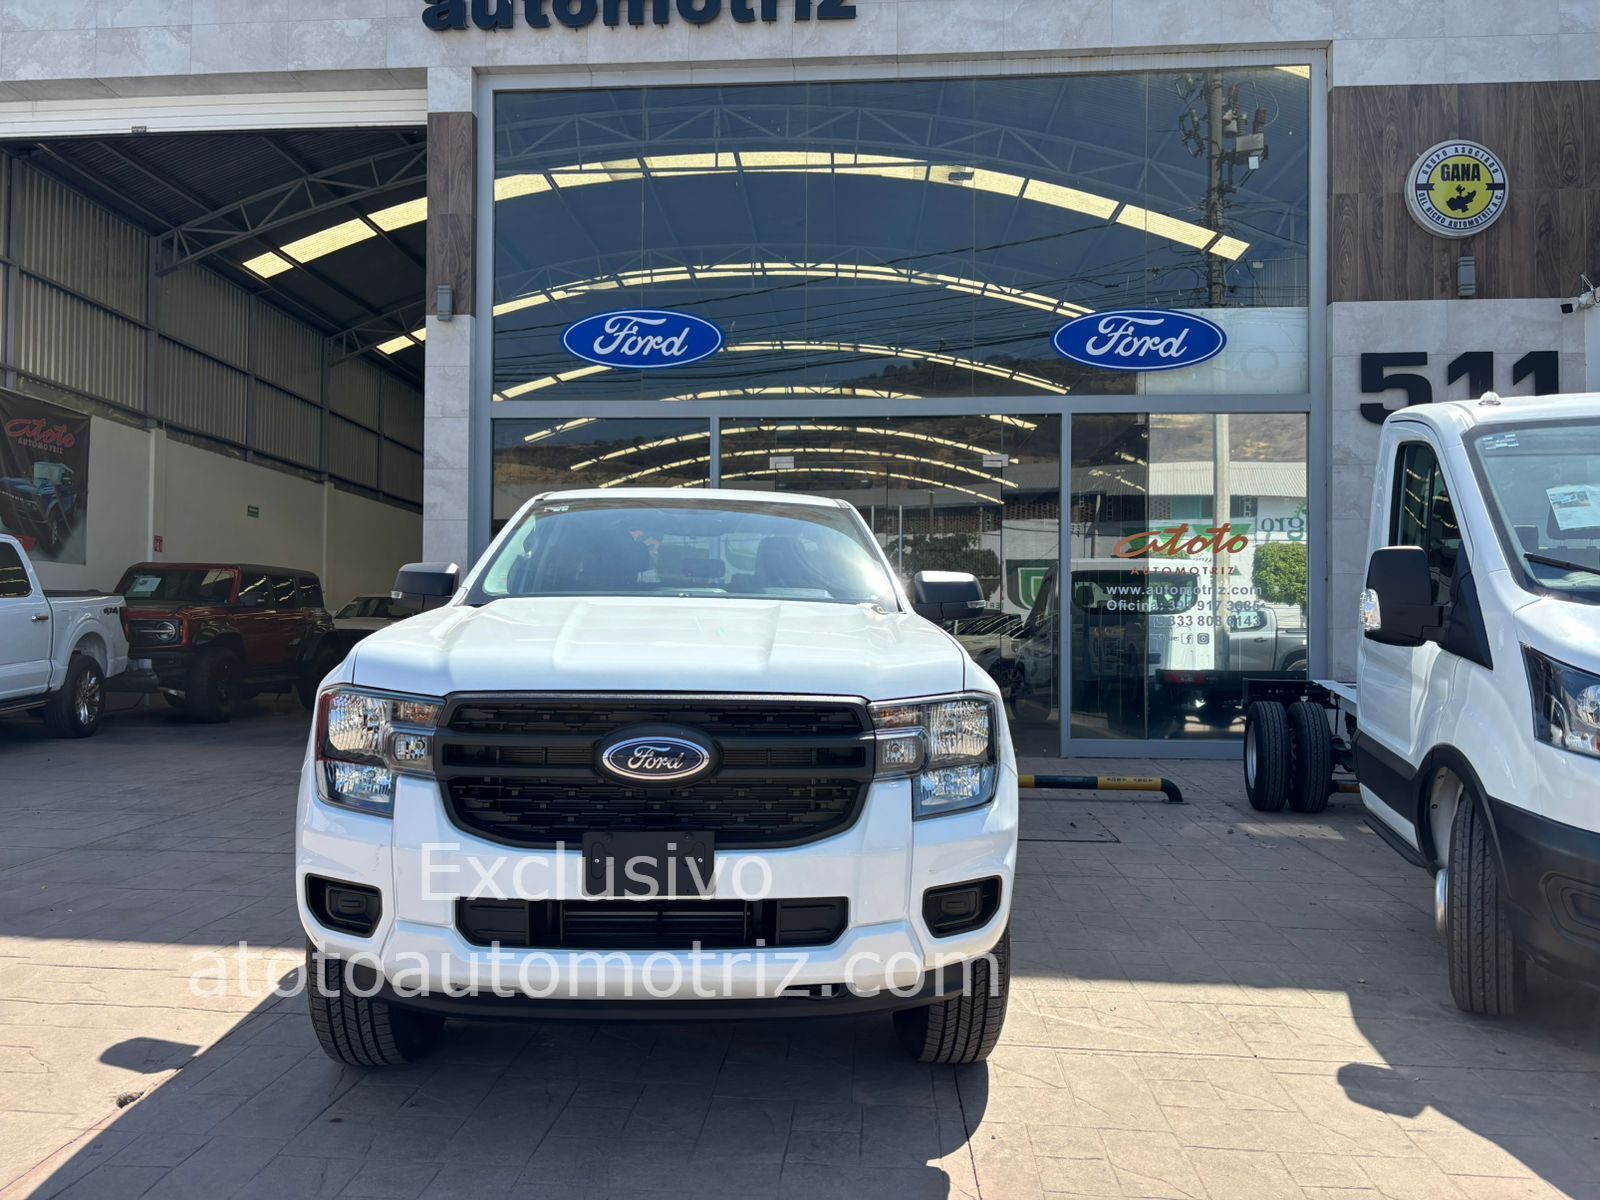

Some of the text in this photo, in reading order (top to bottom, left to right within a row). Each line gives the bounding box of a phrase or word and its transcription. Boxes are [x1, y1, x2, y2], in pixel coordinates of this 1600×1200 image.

[1422, 147, 1500, 176] GRUPO ASOCIADO
[1441, 163, 1481, 182] GANA
[1447, 208, 1494, 228] AUTOMOTRIZ
[593, 315, 691, 357] Ford
[1085, 315, 1190, 358] Ford
[1360, 351, 1559, 425] 511
[1130, 566, 1235, 576] AUTOMOTRIZ
[1106, 599, 1164, 611] Oficina:
[1197, 600, 1222, 611] 917
[627, 745, 685, 769] Ford
